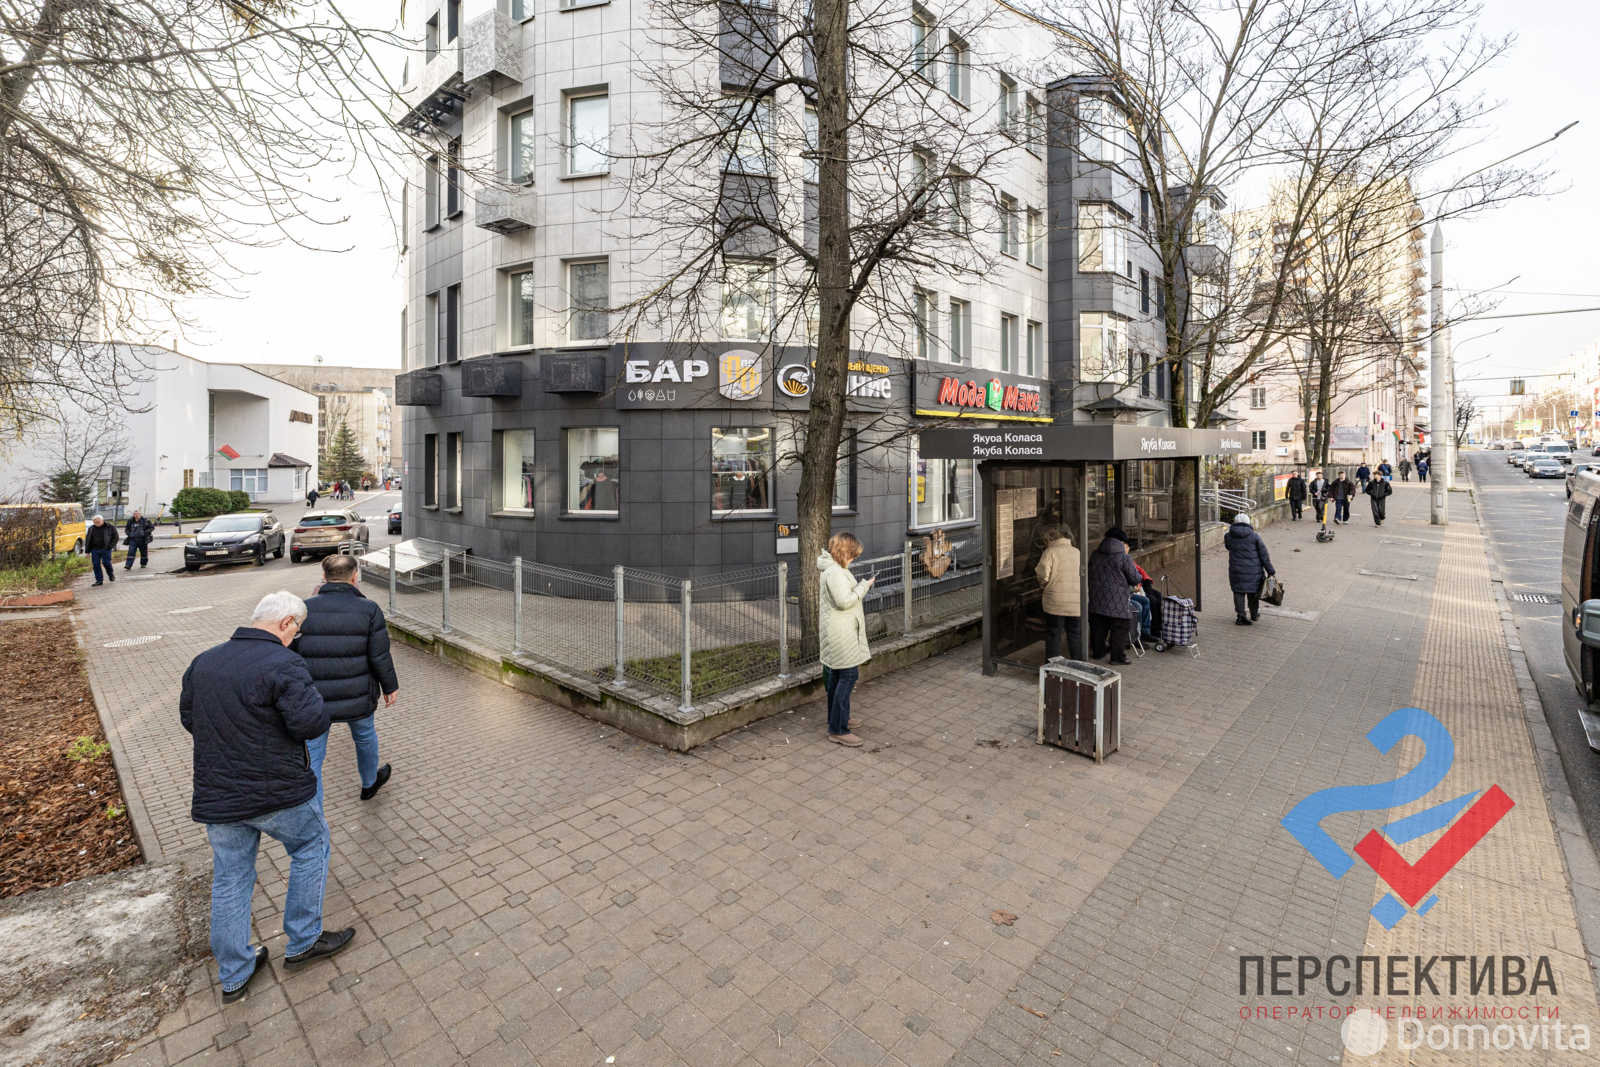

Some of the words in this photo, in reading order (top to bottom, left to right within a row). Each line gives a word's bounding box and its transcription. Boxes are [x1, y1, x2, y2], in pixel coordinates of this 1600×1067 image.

[625, 360, 710, 383] БАР
[938, 377, 987, 408] Мода
[1002, 385, 1040, 412] Макс
[1004, 432, 1043, 442] Коласа
[972, 445, 1002, 457] Якуба
[1004, 445, 1043, 455] Коласа
